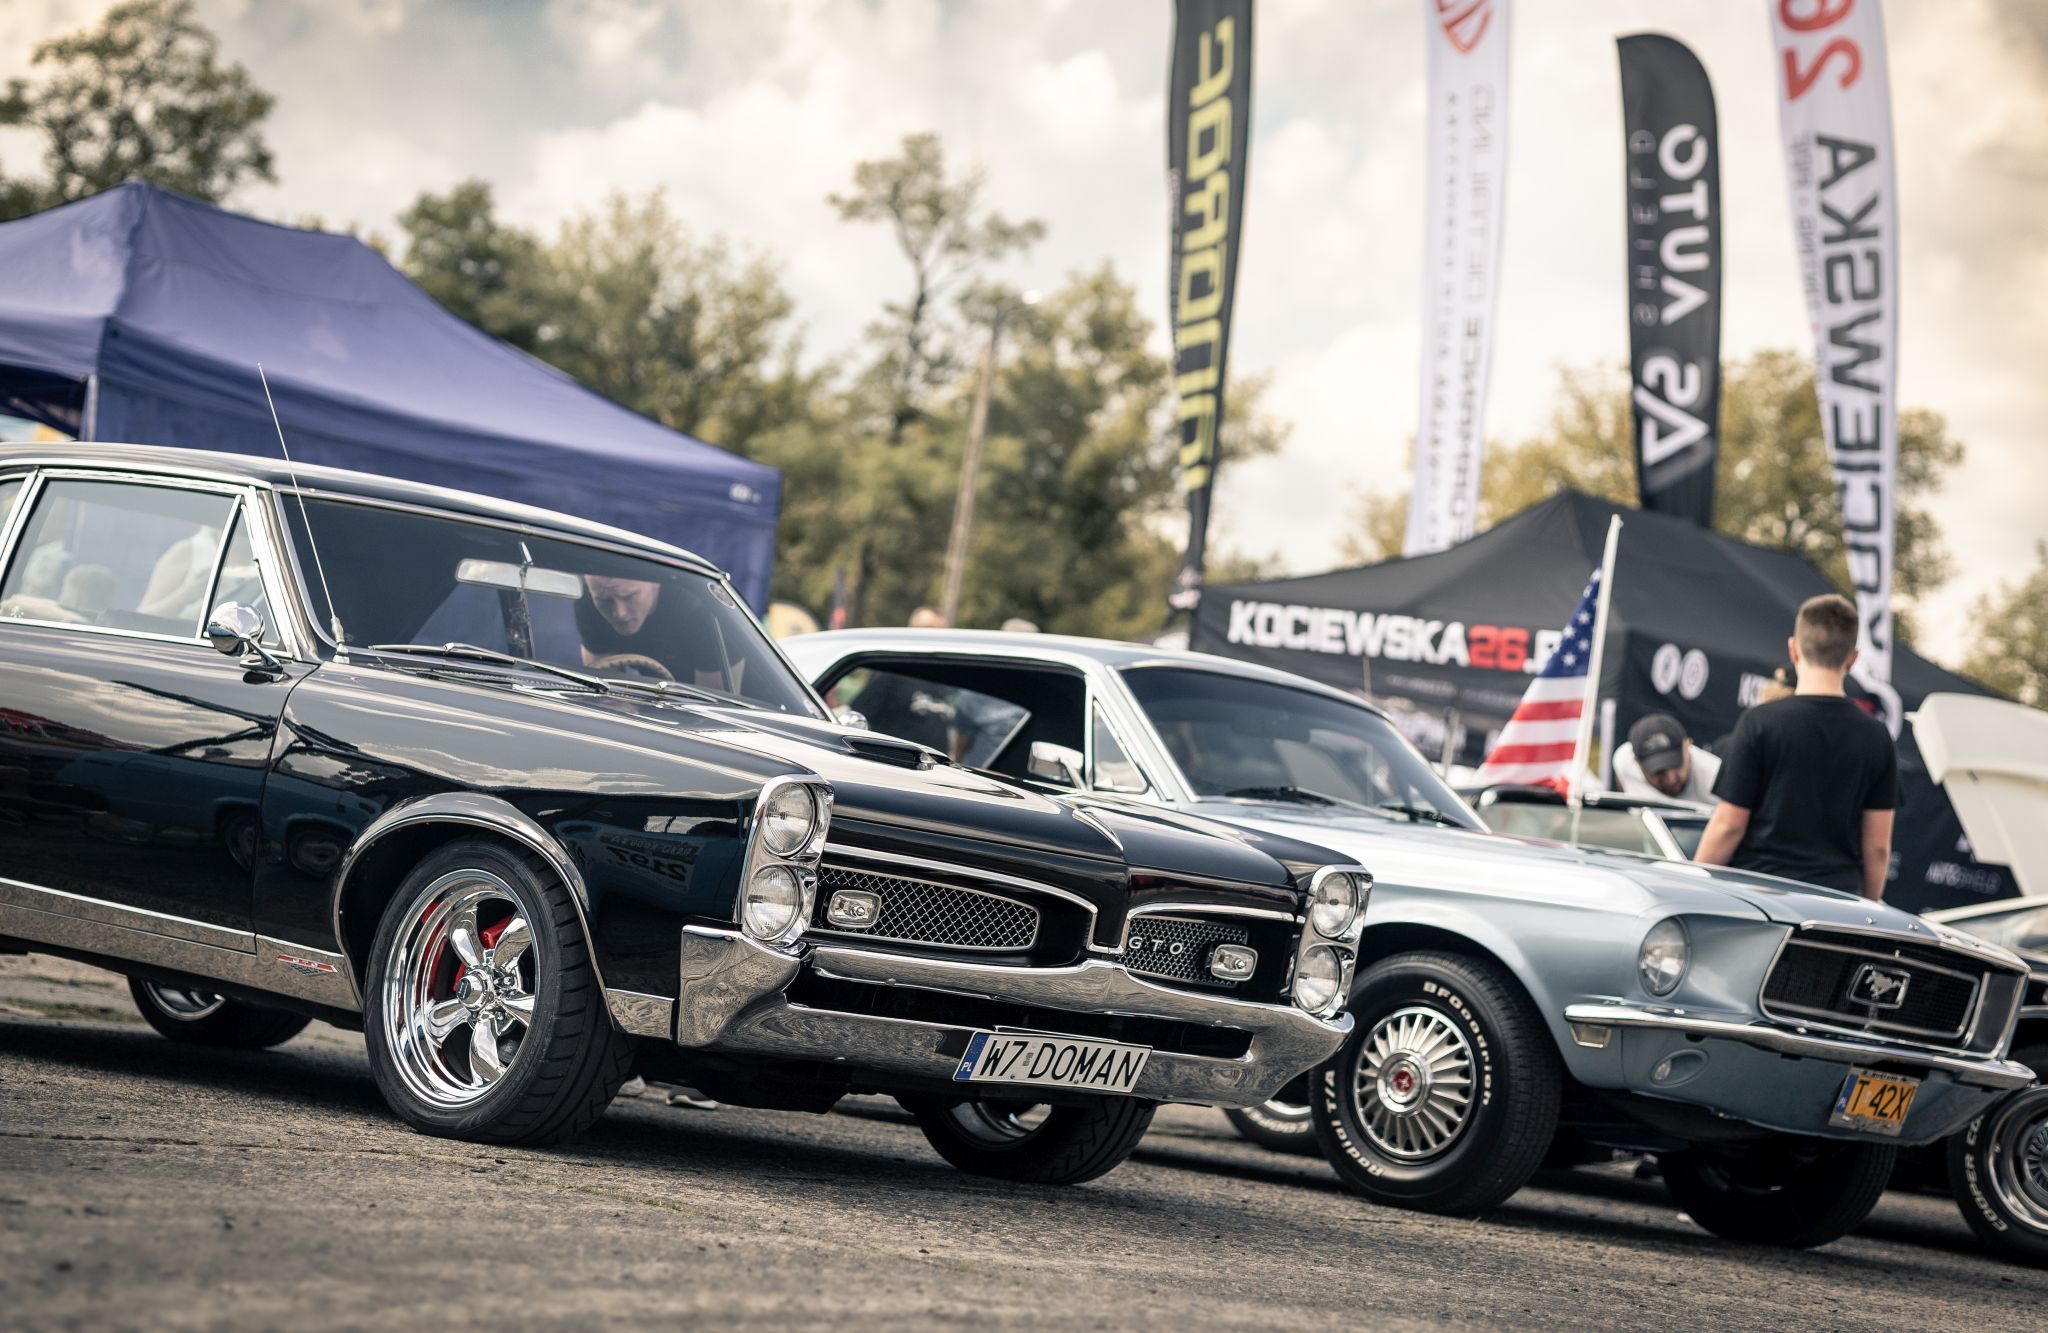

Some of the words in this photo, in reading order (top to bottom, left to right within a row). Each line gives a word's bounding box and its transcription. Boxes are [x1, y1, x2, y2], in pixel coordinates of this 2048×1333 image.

[1128, 936, 1184, 955] GTO
[960, 1061, 974, 1073] PL
[979, 1039, 1030, 1077] W7
[1027, 1042, 1145, 1088] DOMAN
[1324, 1069, 1336, 1114] T/A
[1850, 1079, 1871, 1113] T
[1868, 1083, 1912, 1120] 42X
[1964, 1153, 2009, 1231] COOPER
